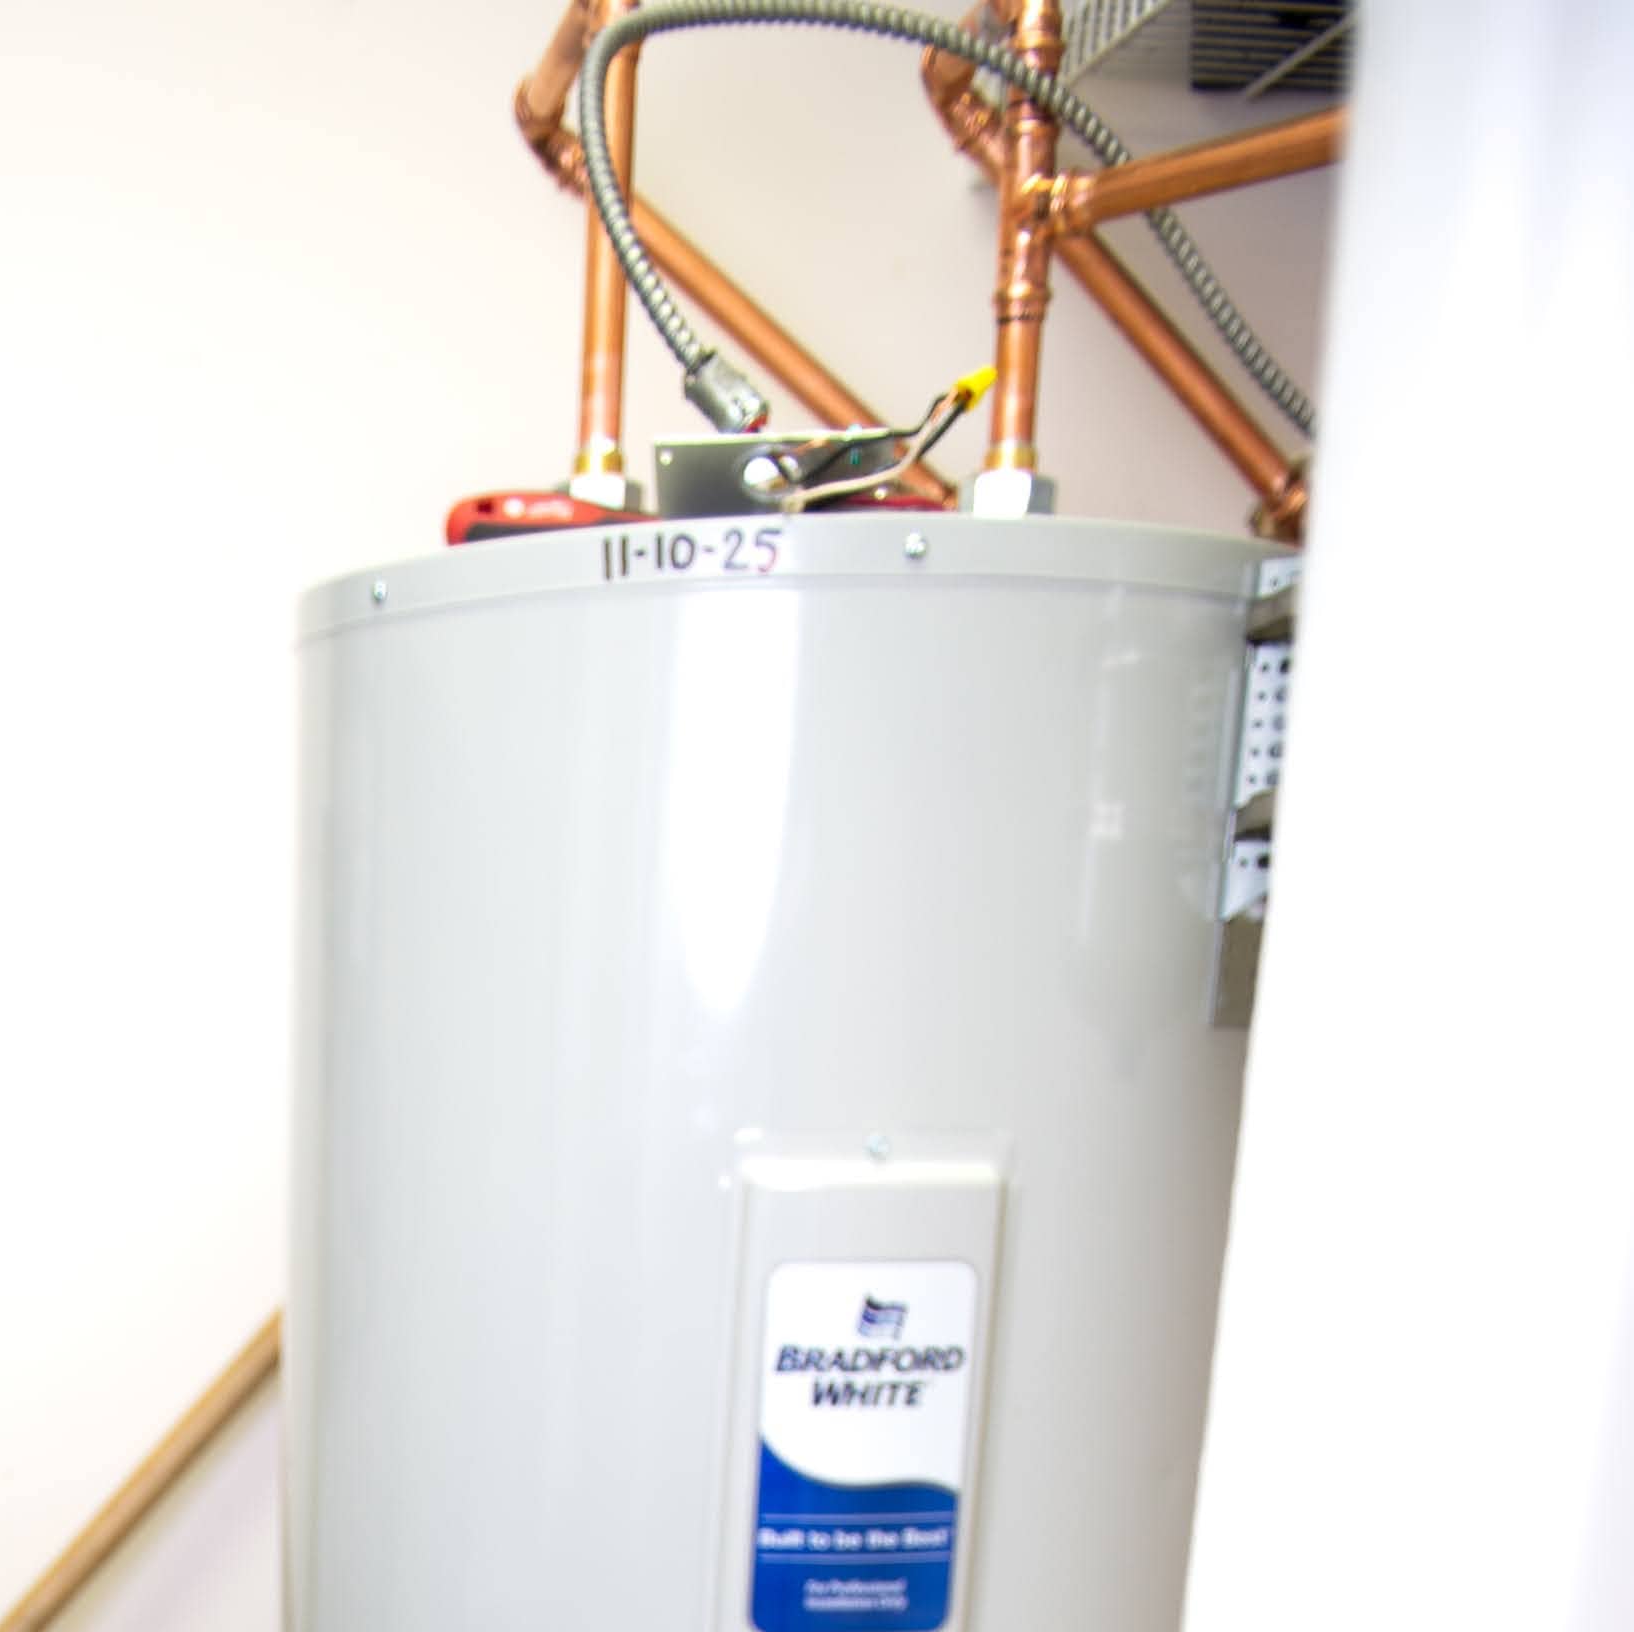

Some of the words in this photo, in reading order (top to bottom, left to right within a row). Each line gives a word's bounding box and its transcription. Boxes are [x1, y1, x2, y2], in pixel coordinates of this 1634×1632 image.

[603, 527, 783, 581] 11-10-25
[776, 1345, 965, 1372] BRADFORD
[813, 1379, 925, 1406] WHITE
